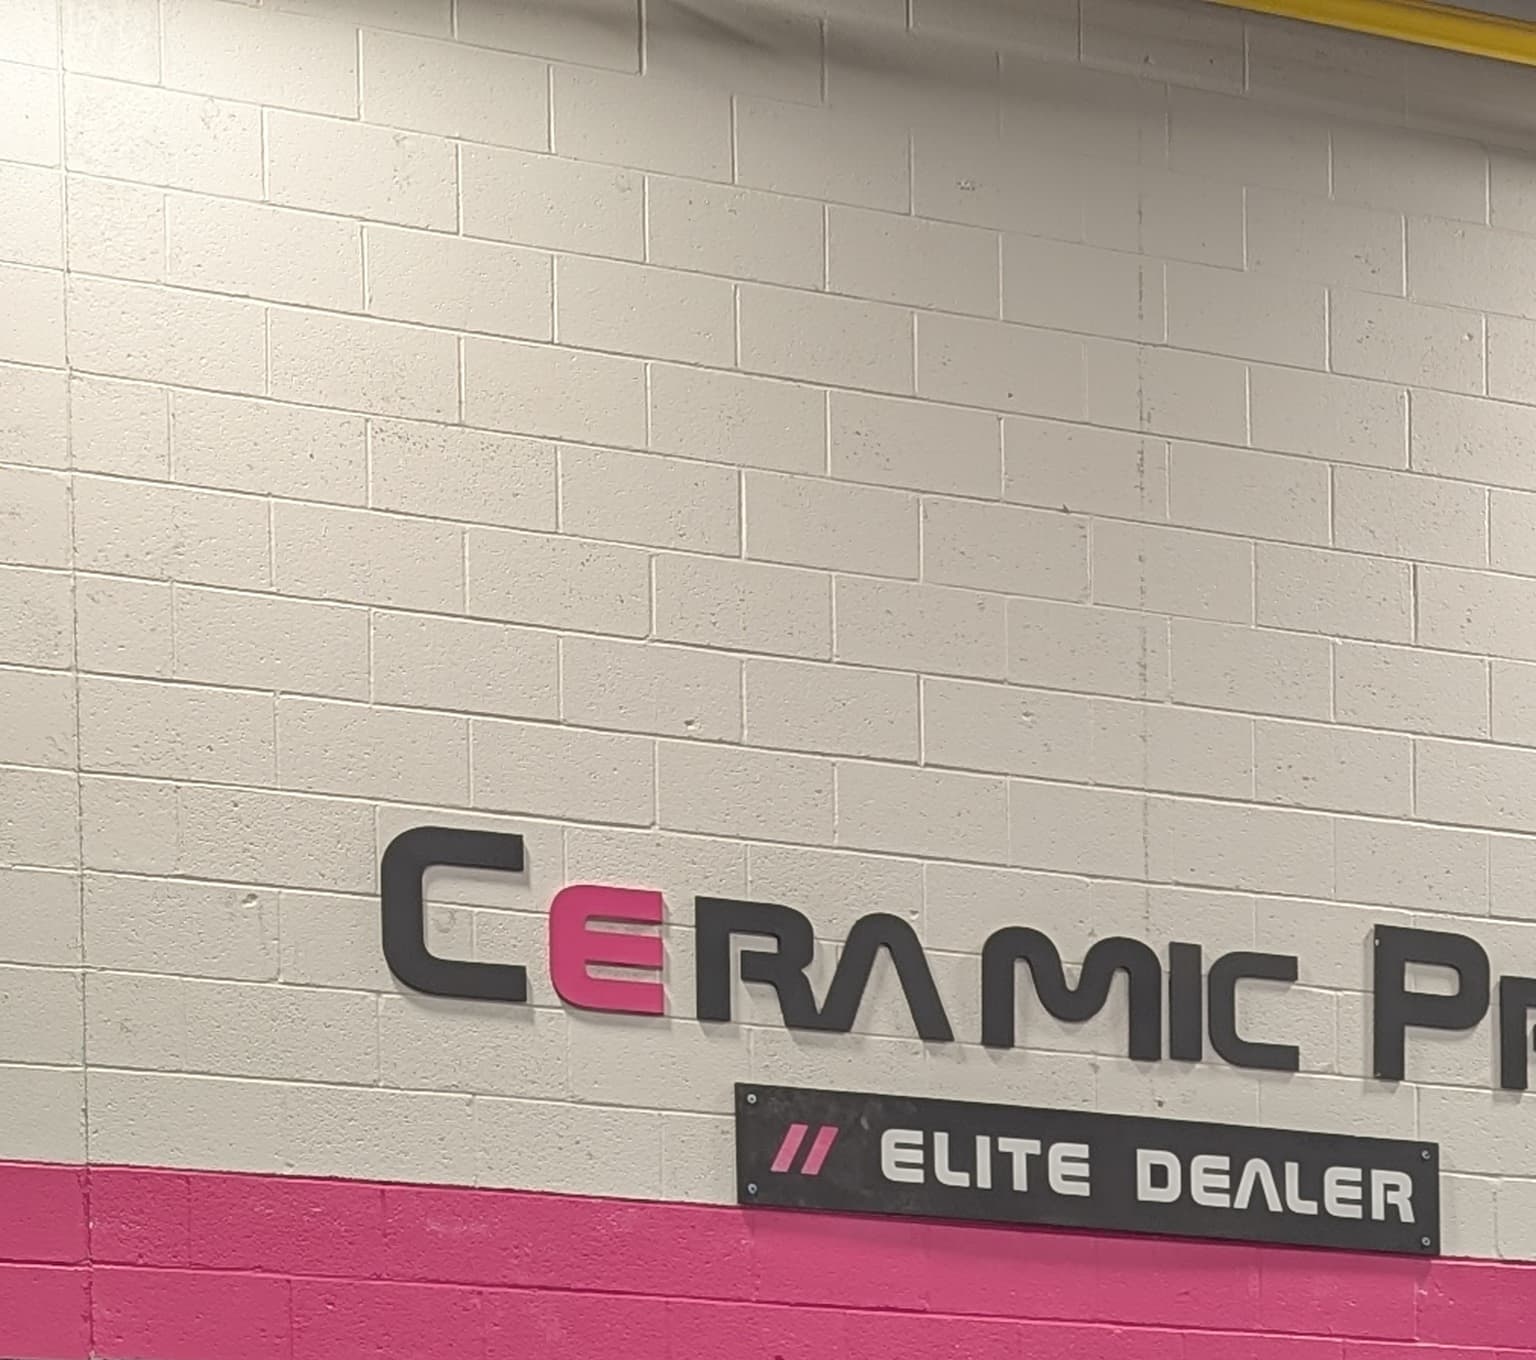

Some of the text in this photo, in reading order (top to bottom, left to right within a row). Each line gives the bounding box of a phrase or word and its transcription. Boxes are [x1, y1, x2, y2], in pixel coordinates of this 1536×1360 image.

[381, 826, 1300, 1072] CERAMIC
[881, 1128, 1416, 1224] ELITE DEALER
